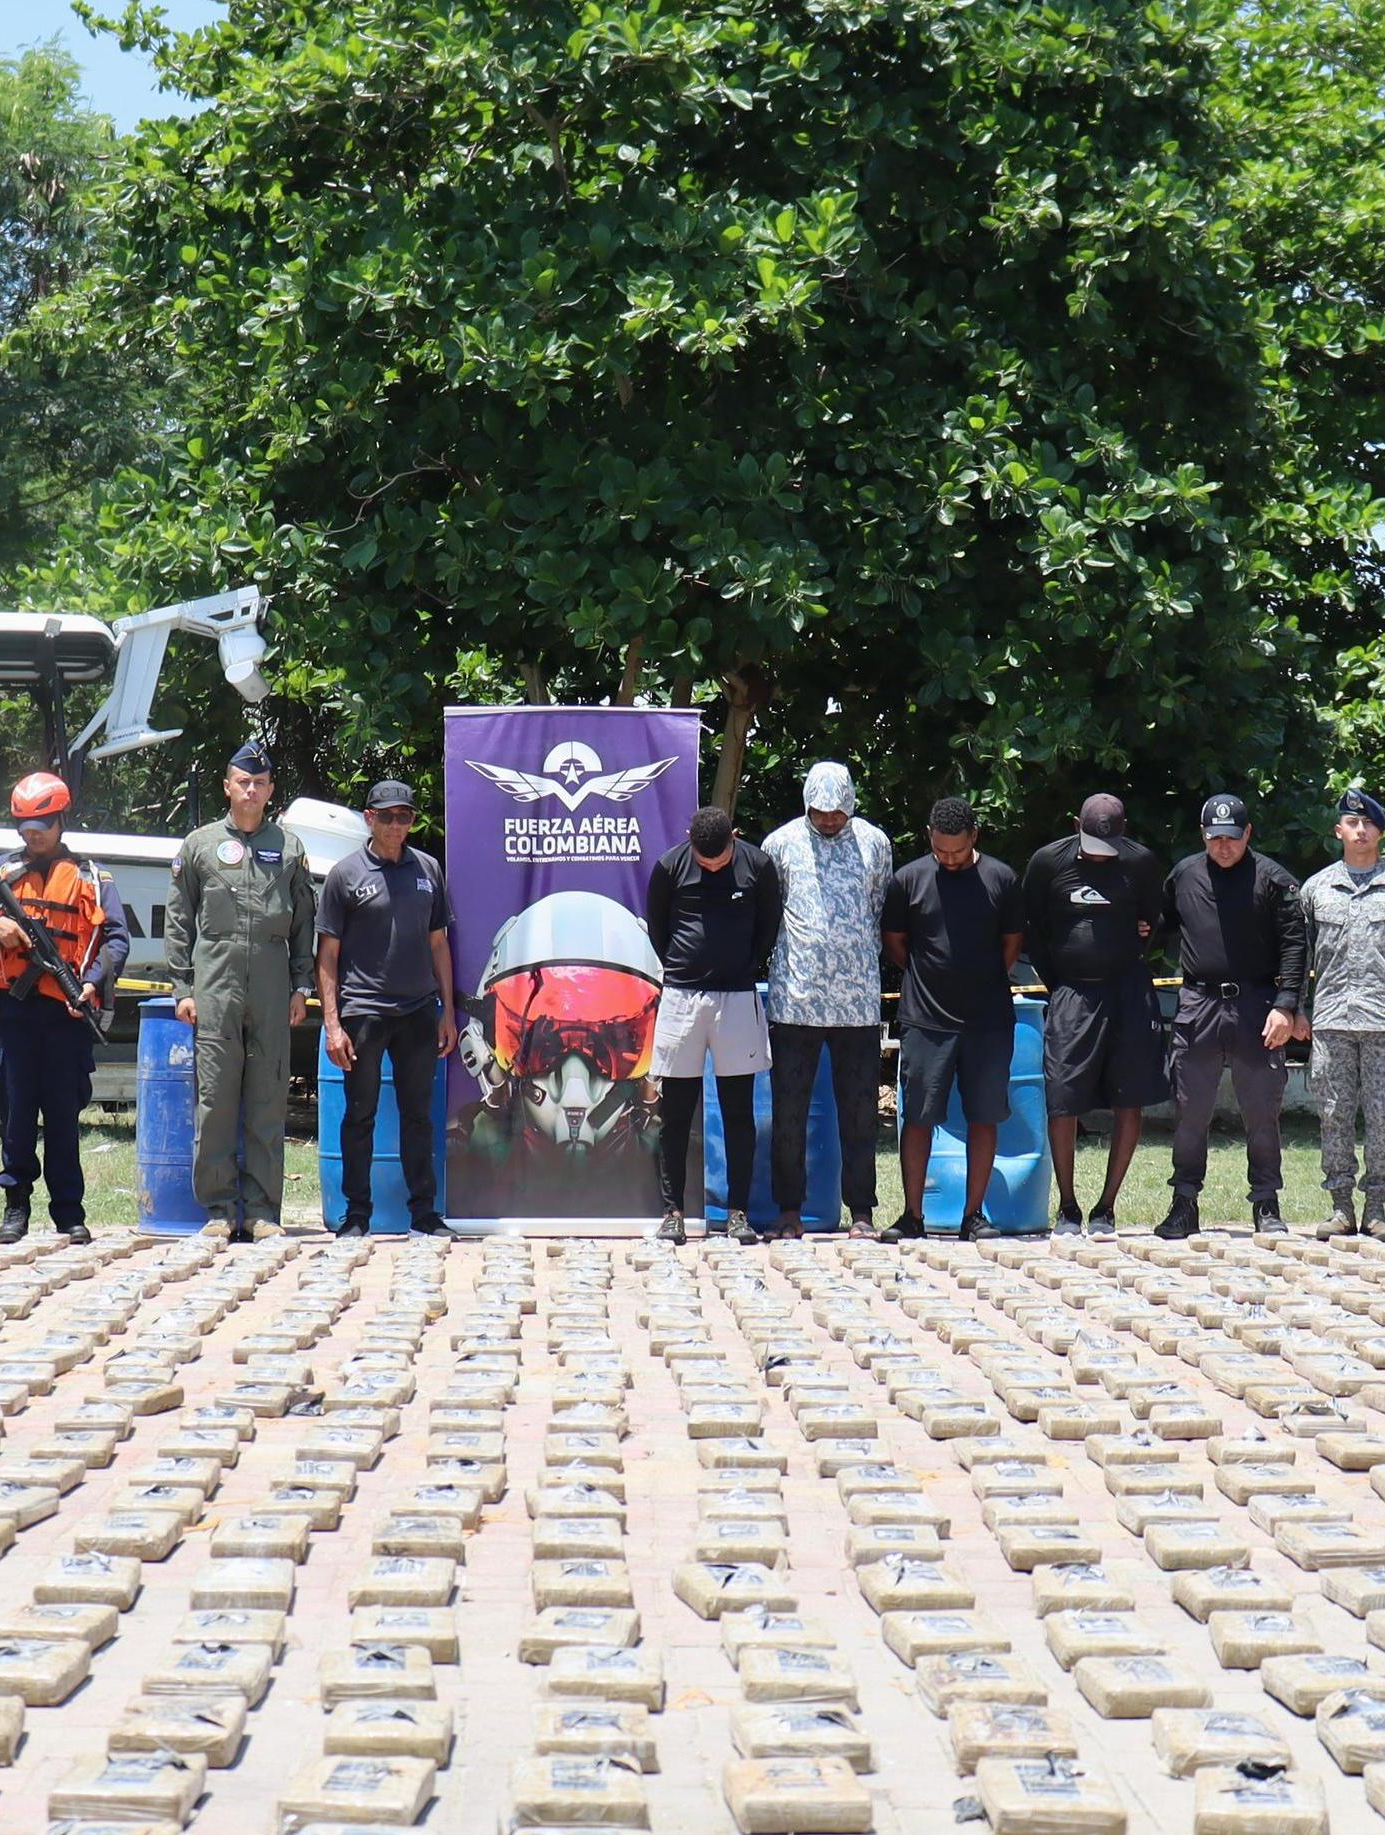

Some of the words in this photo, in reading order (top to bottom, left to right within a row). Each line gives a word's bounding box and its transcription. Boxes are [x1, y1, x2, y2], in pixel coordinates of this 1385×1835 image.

[380, 787, 408, 799] CTI
[504, 818, 575, 835] FUERZA
[579, 813, 640, 834] AÉREA
[505, 835, 641, 855] COLOMBIANA
[355, 884, 377, 898] CTI
